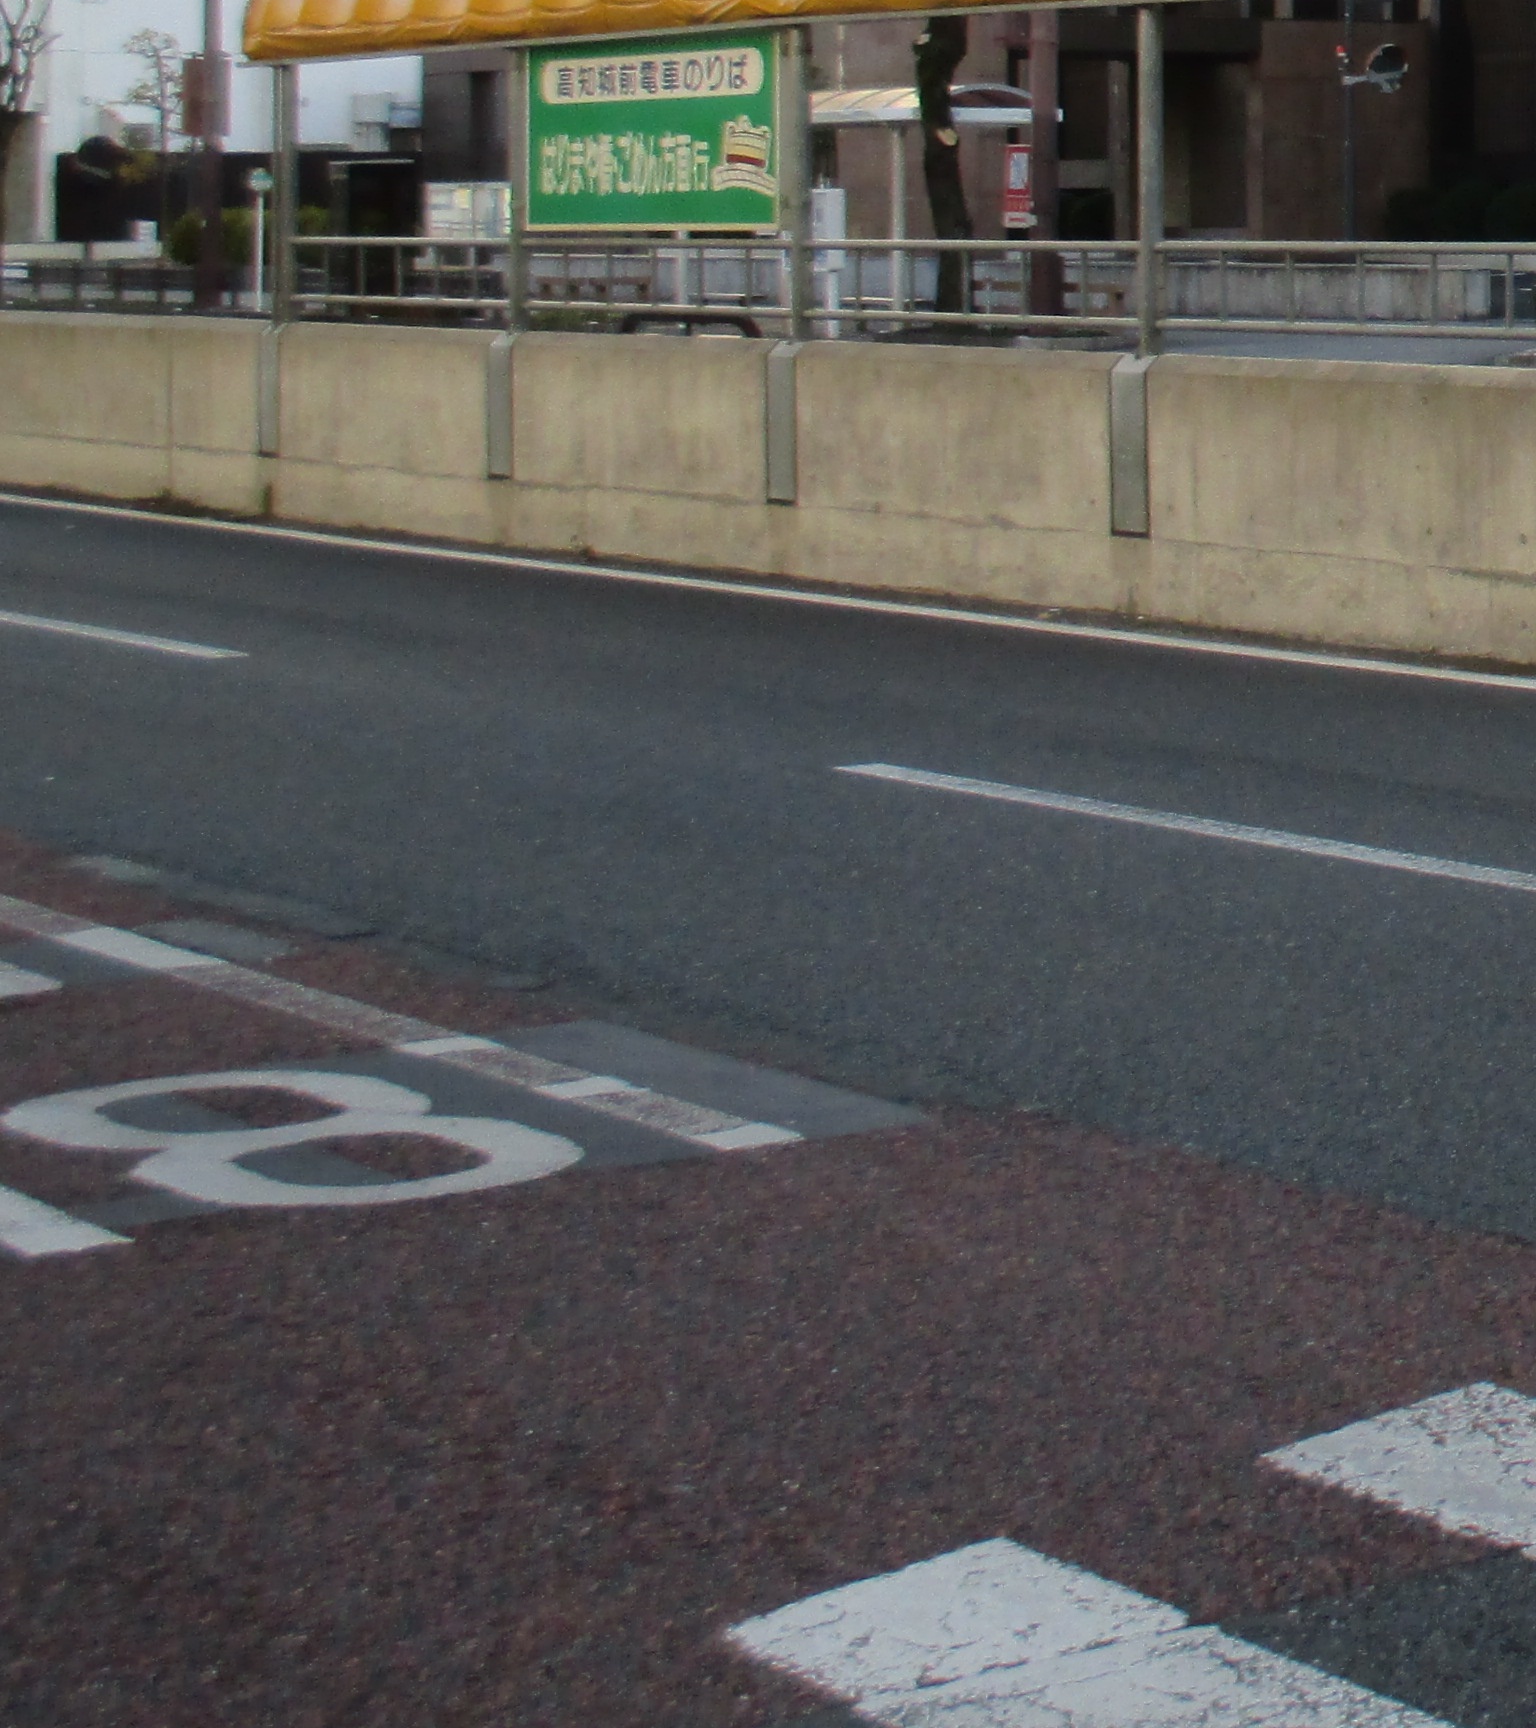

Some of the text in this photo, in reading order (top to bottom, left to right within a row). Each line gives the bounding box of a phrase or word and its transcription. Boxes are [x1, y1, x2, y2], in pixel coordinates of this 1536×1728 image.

[556, 53, 749, 99] 高知城前電車のりば
